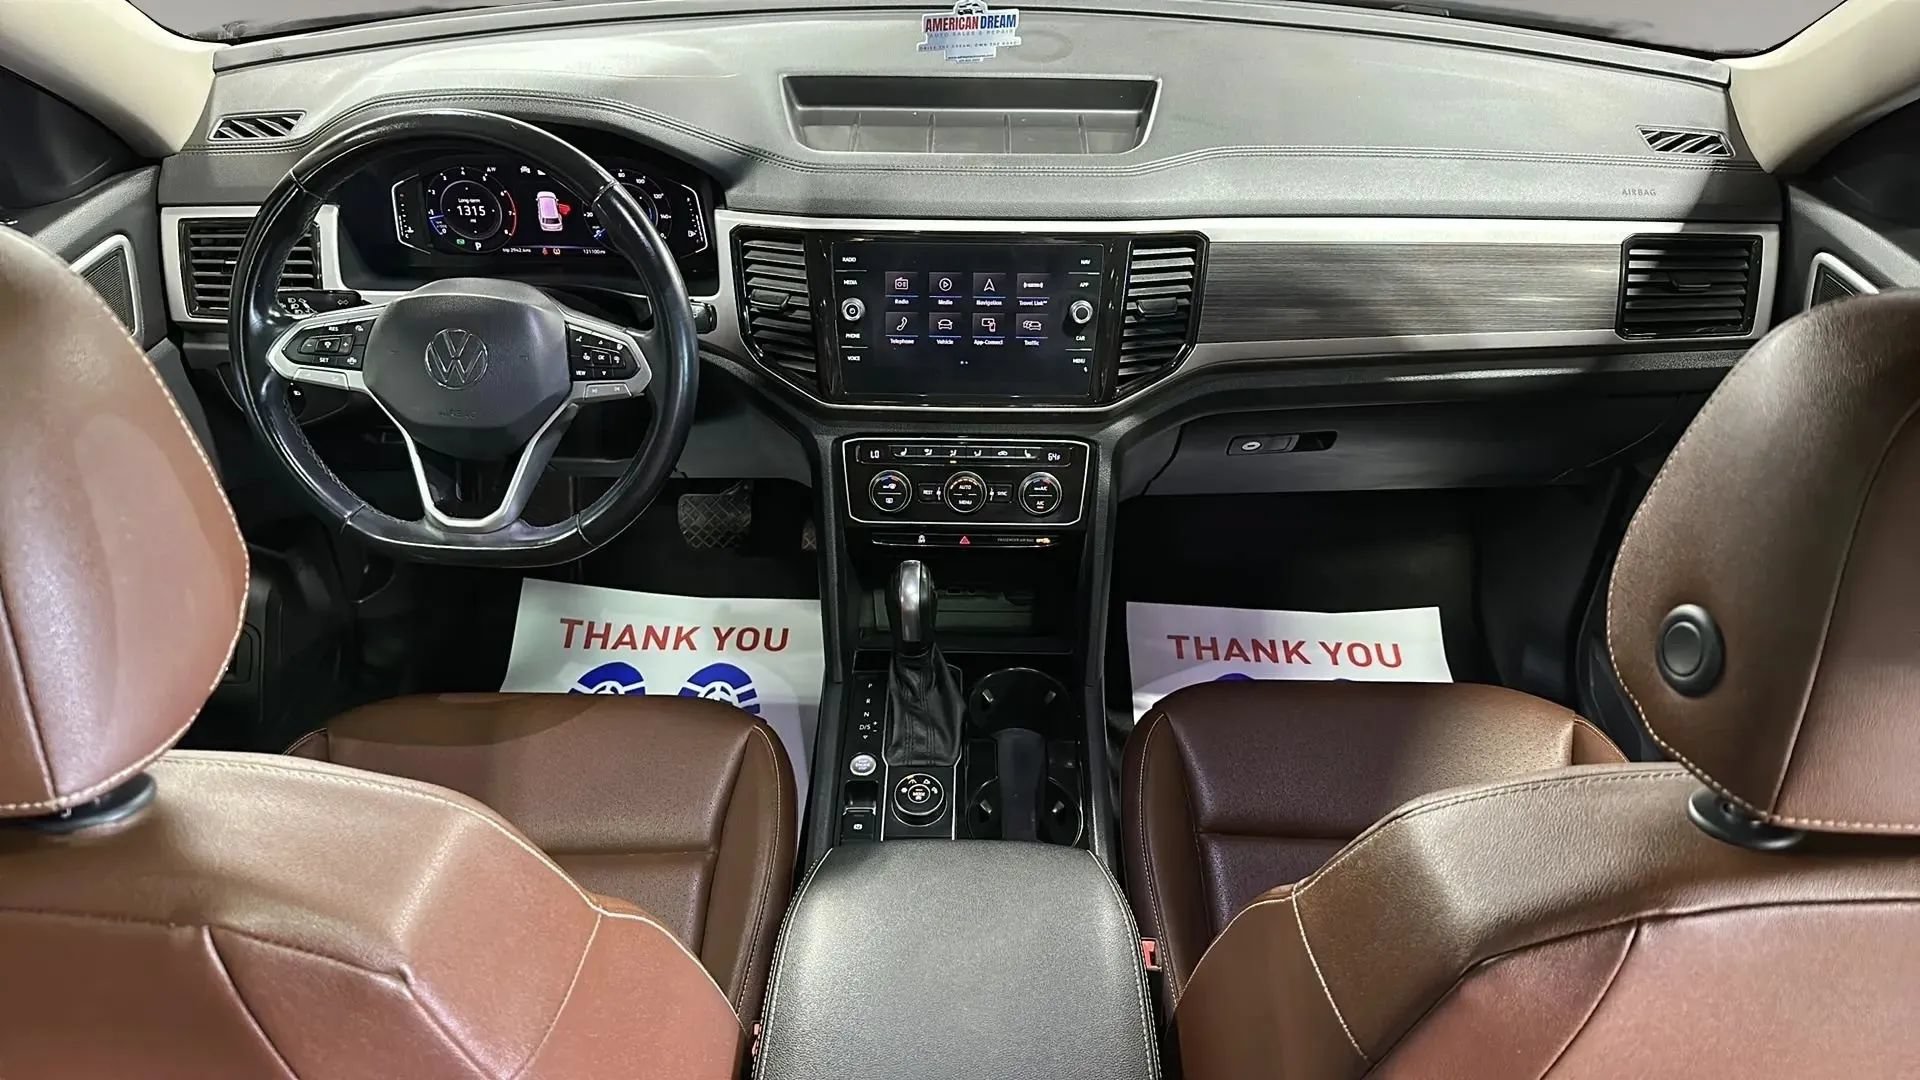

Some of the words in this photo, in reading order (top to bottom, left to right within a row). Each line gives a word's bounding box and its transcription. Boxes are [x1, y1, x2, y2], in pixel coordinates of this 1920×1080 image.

[925, 16, 979, 32] AMERICAN
[980, 14, 1017, 29] DREAM
[1622, 188, 1657, 196] AIRBAG
[456, 205, 486, 216] 1315
[475, 241, 482, 251] P
[560, 617, 701, 651] THANK
[712, 625, 790, 652] YOU
[1166, 634, 1312, 665] THANK
[1318, 640, 1402, 668] YOU
